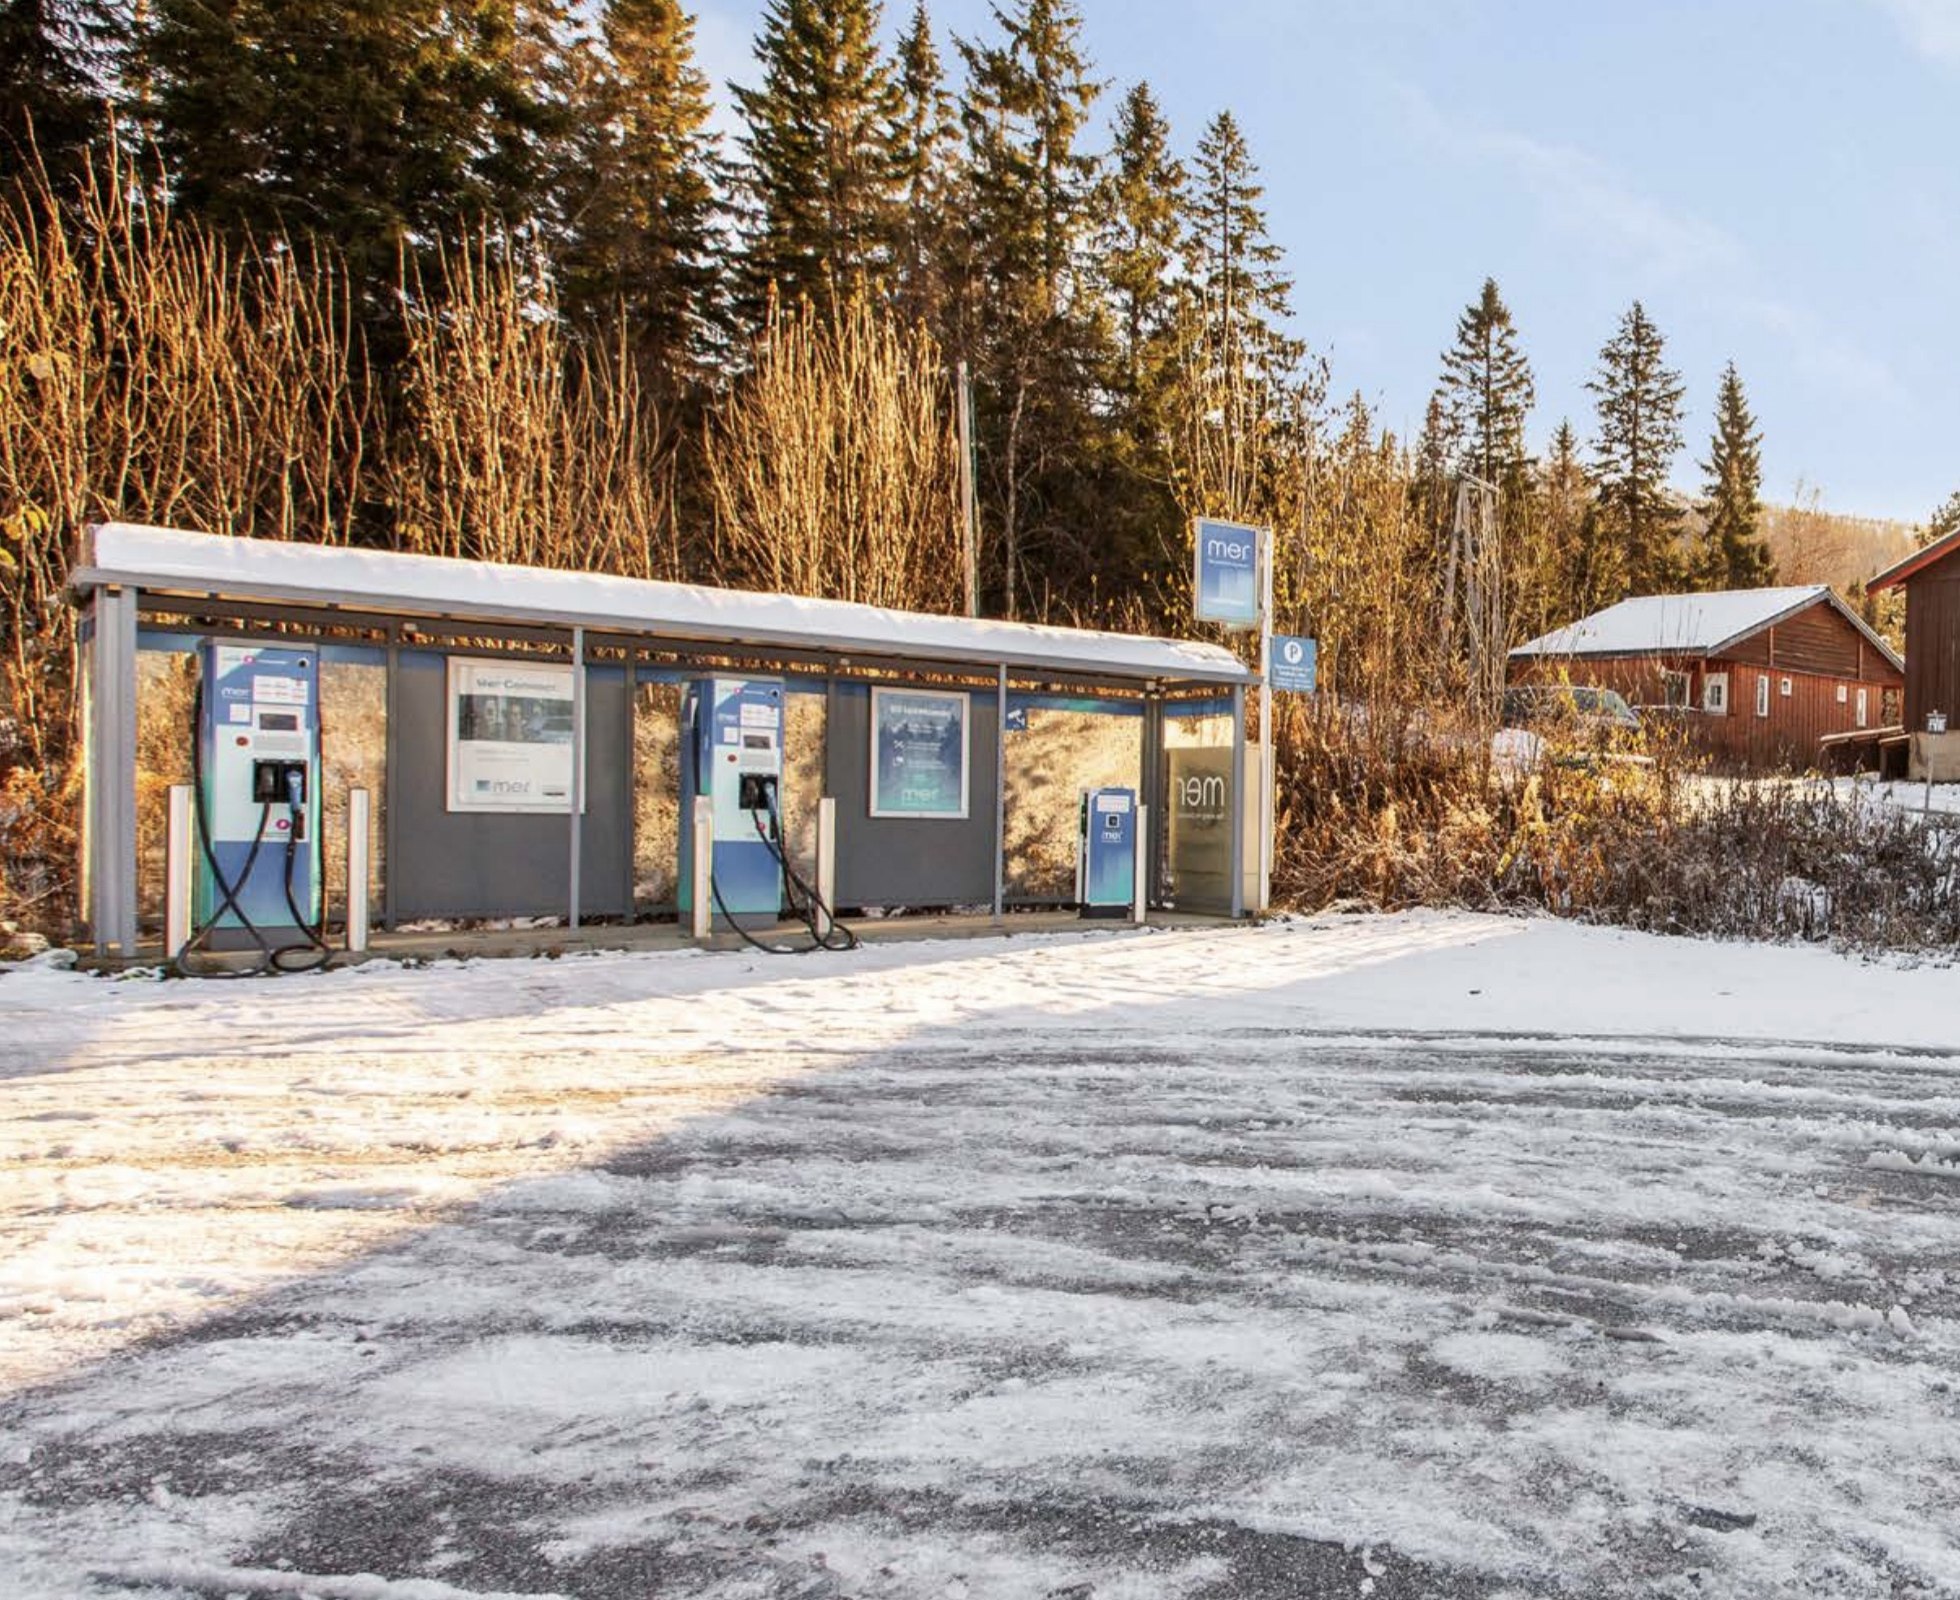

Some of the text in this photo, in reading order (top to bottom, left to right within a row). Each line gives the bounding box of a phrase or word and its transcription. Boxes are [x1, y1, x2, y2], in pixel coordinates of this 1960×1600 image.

[1208, 539, 1250, 559] mer
[1290, 645, 1298, 659] P
[493, 781, 530, 792] mer
